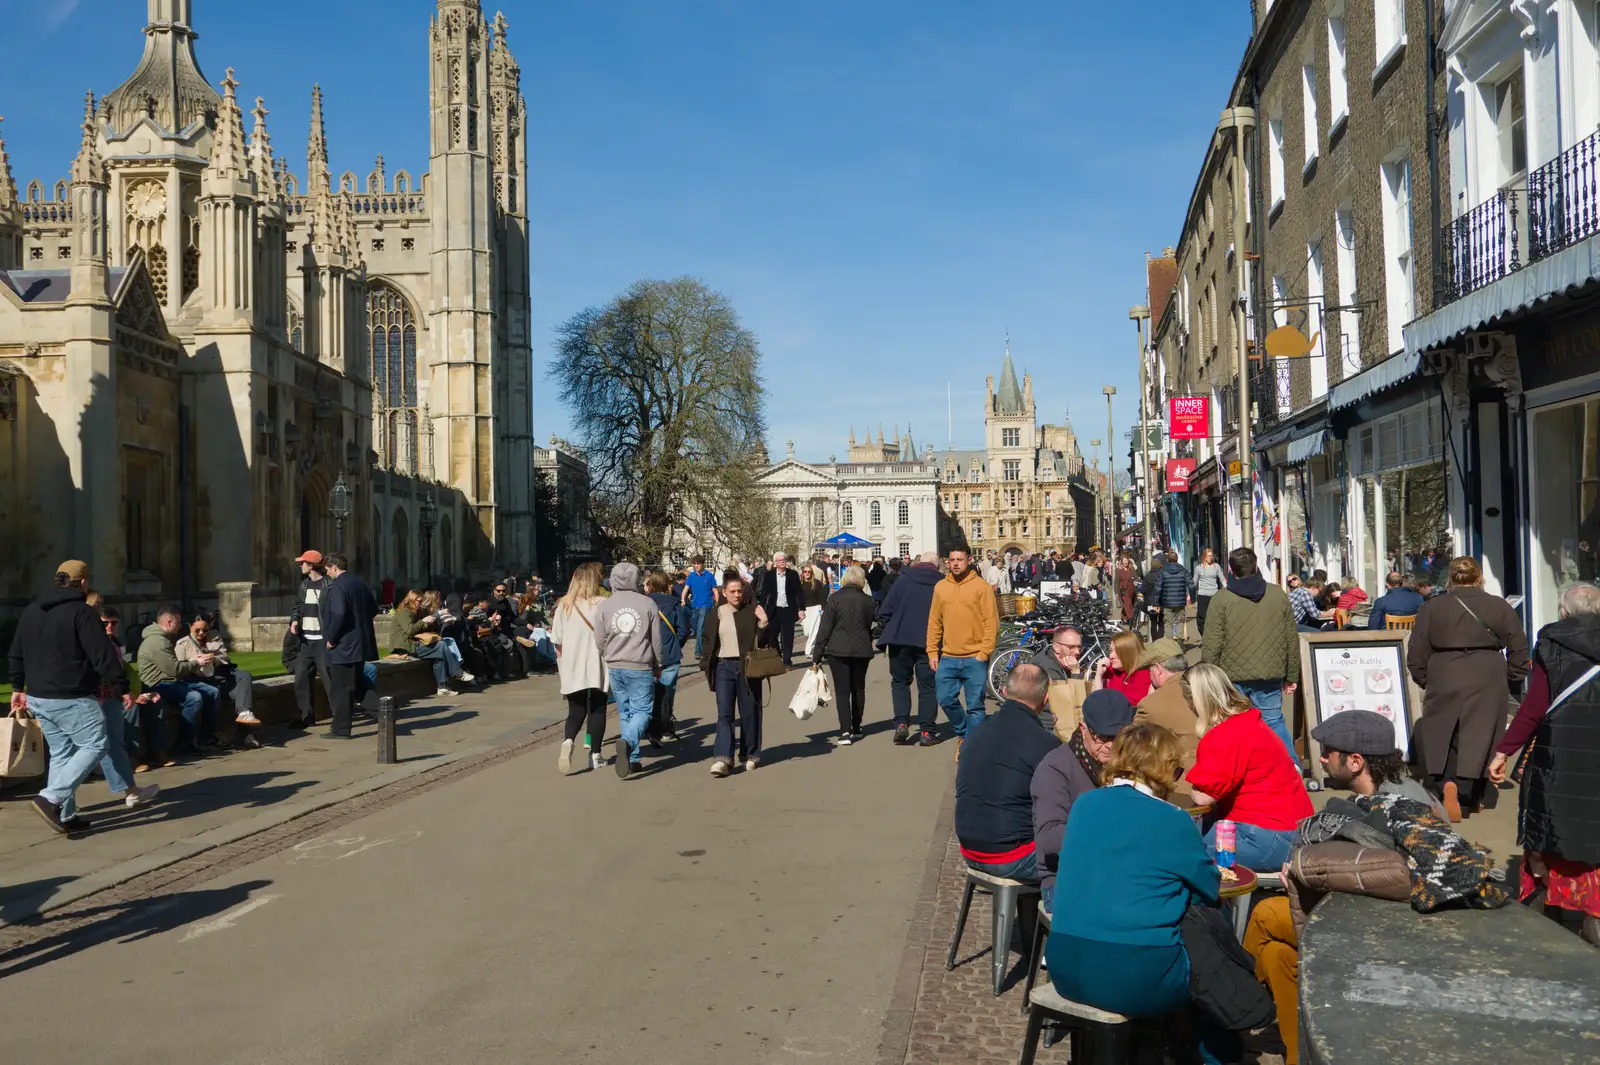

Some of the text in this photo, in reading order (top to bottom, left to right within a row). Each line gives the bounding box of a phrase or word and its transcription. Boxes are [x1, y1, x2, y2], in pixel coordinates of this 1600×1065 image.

[1175, 399, 1203, 407] INNER
[1175, 407, 1204, 415] SPACE
[1330, 657, 1382, 666] Copper Kettle
